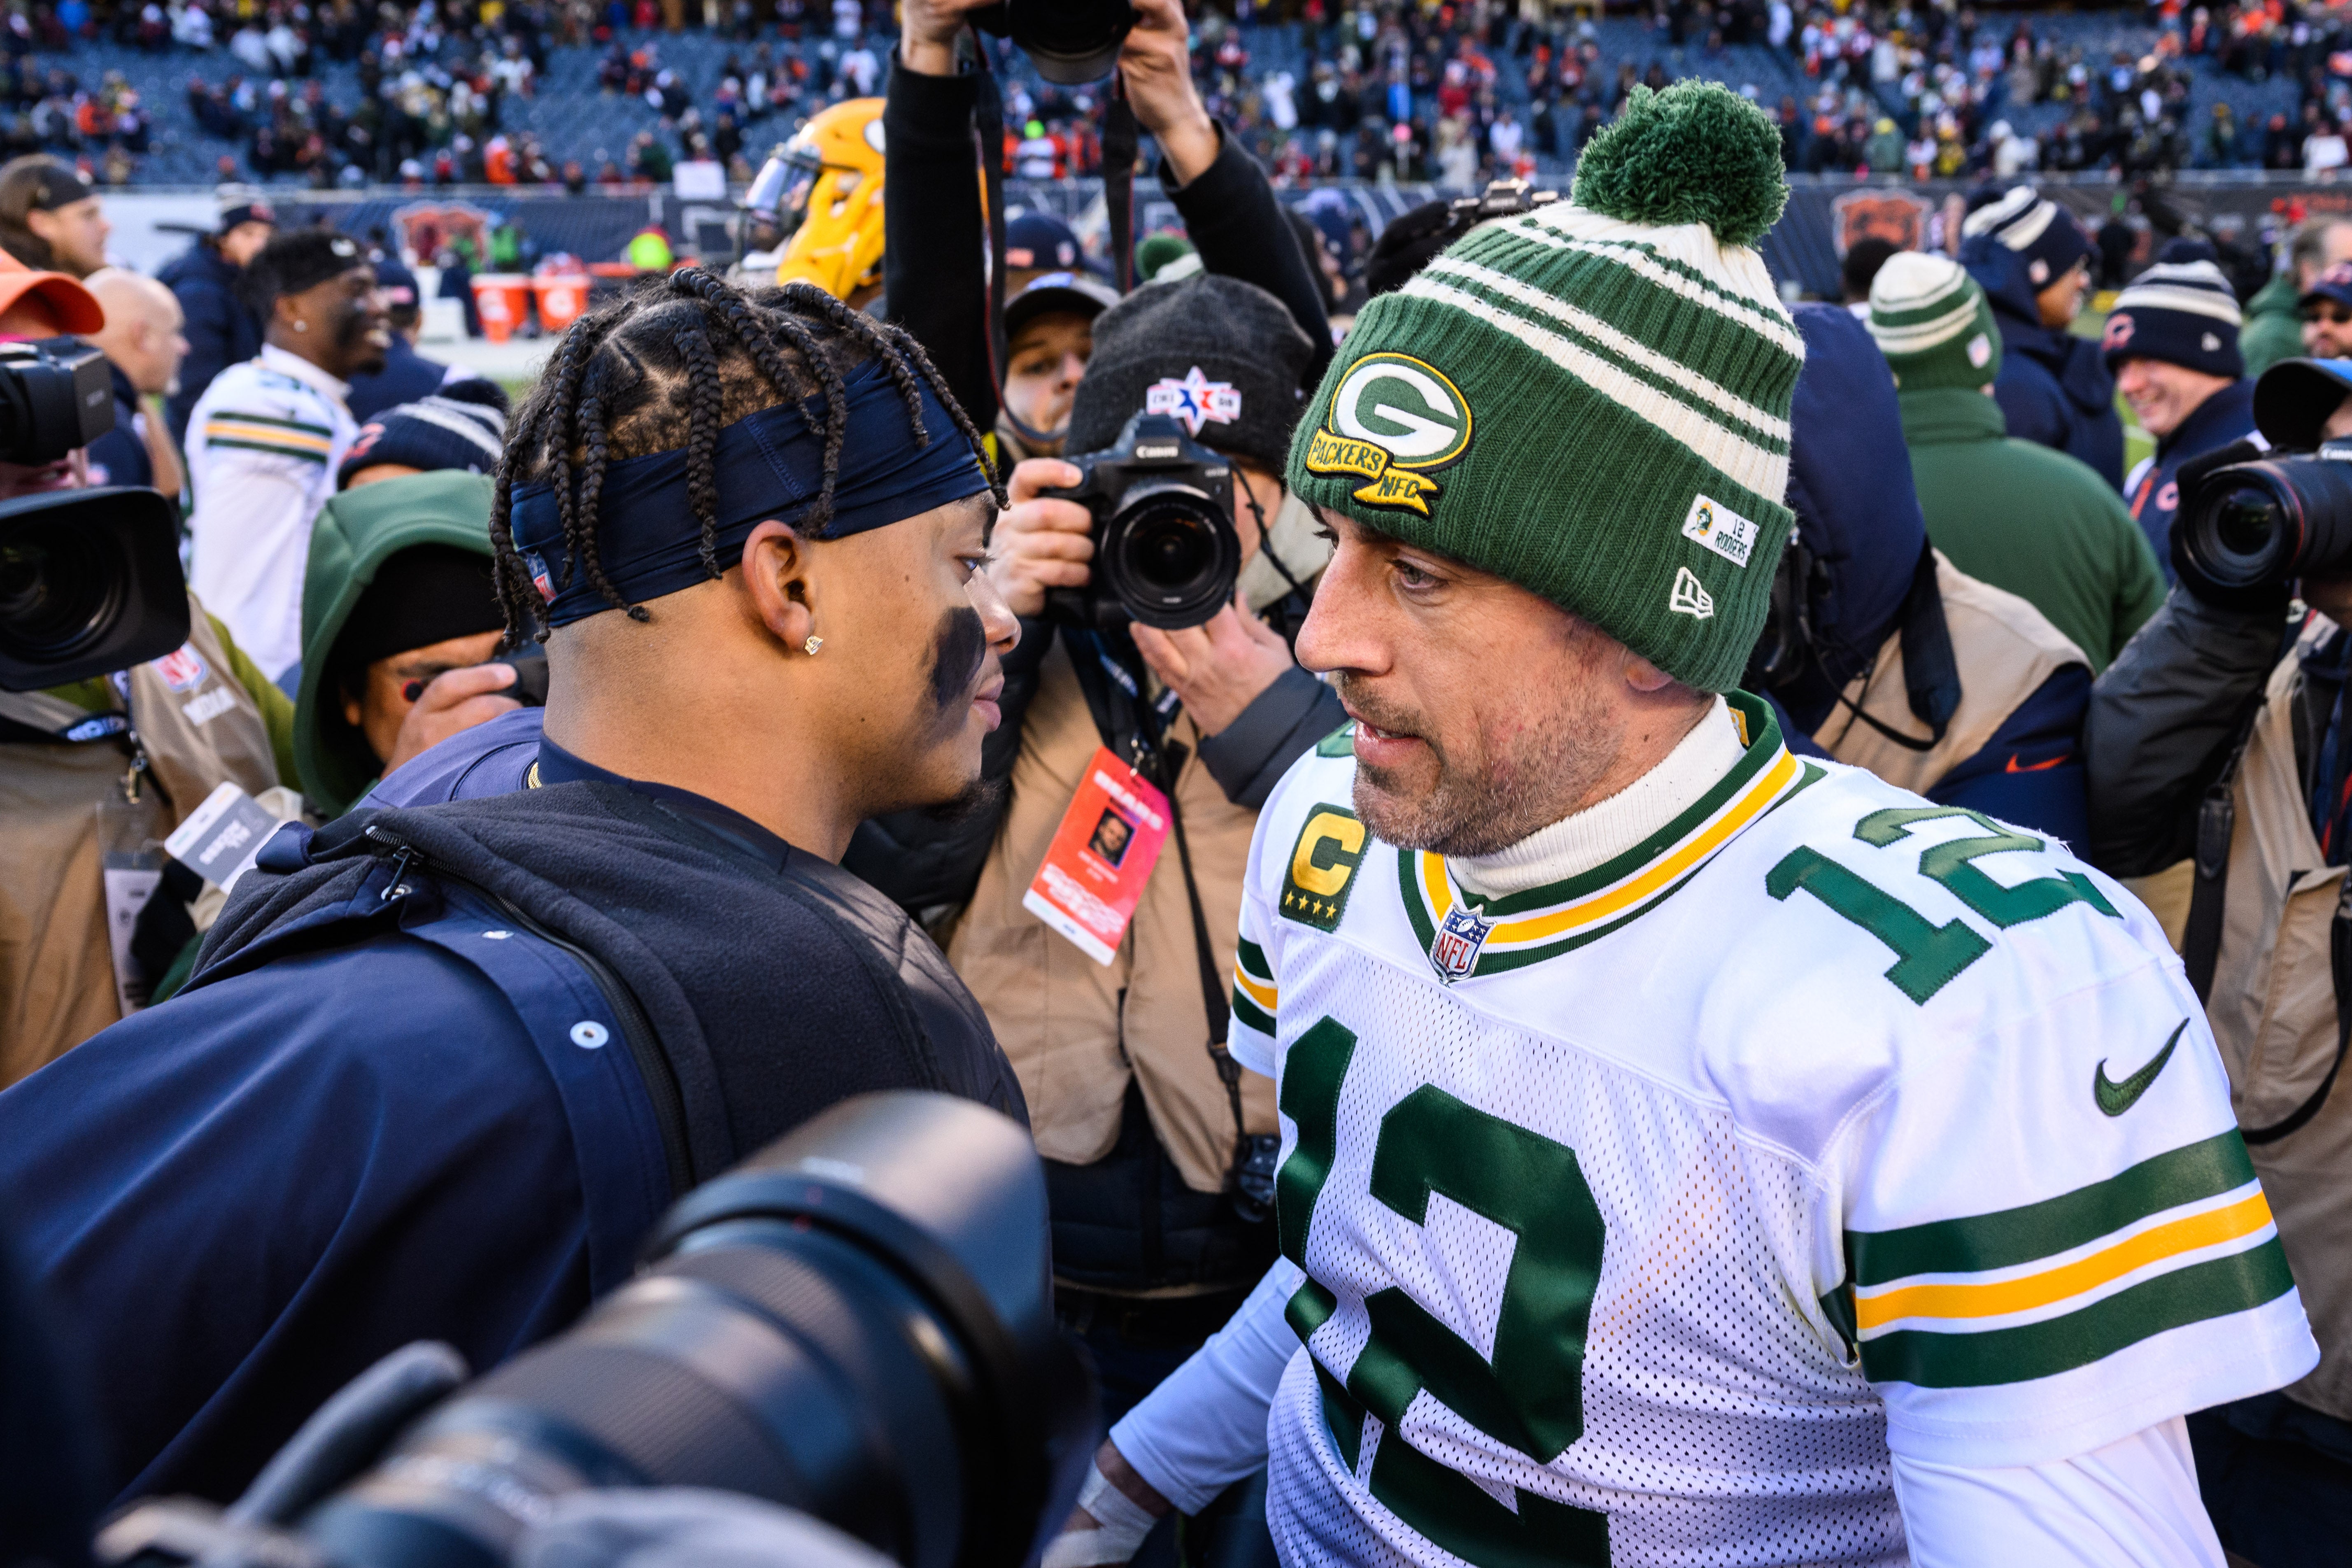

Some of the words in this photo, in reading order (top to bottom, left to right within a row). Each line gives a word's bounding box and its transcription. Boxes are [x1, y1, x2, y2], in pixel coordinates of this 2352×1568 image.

[1336, 363, 1459, 457] G
[1309, 437, 1382, 471] PACKERS
[1377, 475, 1420, 501] NFC
[1716, 531, 1747, 560] RODGERS
[1733, 518, 1745, 538] 12
[1292, 812, 1365, 897] C
[1766, 806, 2125, 1007] 12
[1435, 932, 1470, 969] NFL
[1276, 1015, 1609, 1568] 12
